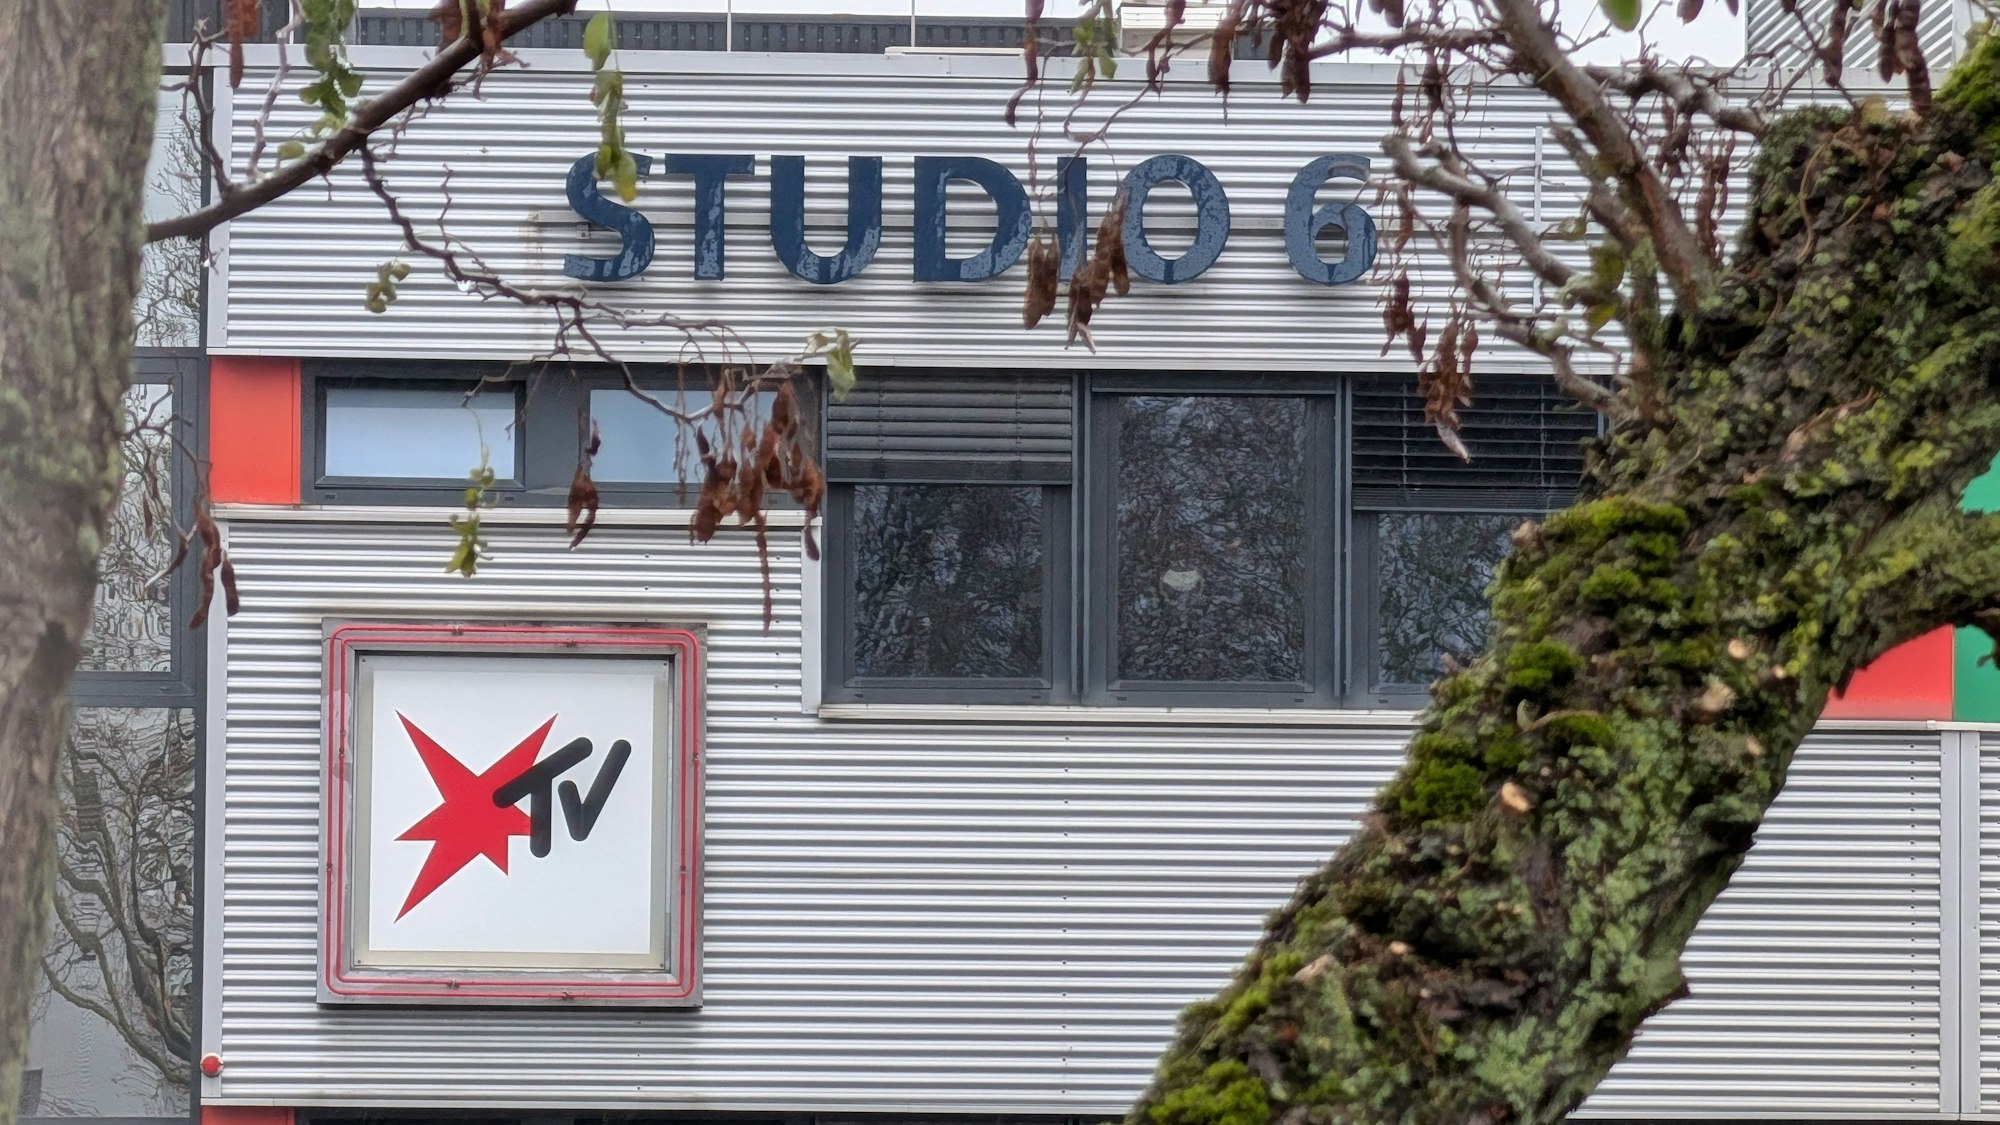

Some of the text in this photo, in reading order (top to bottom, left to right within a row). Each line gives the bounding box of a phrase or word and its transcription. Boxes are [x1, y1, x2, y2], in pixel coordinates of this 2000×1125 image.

[563, 151, 1378, 286] STUDIO 6
[492, 736, 632, 858] TV
